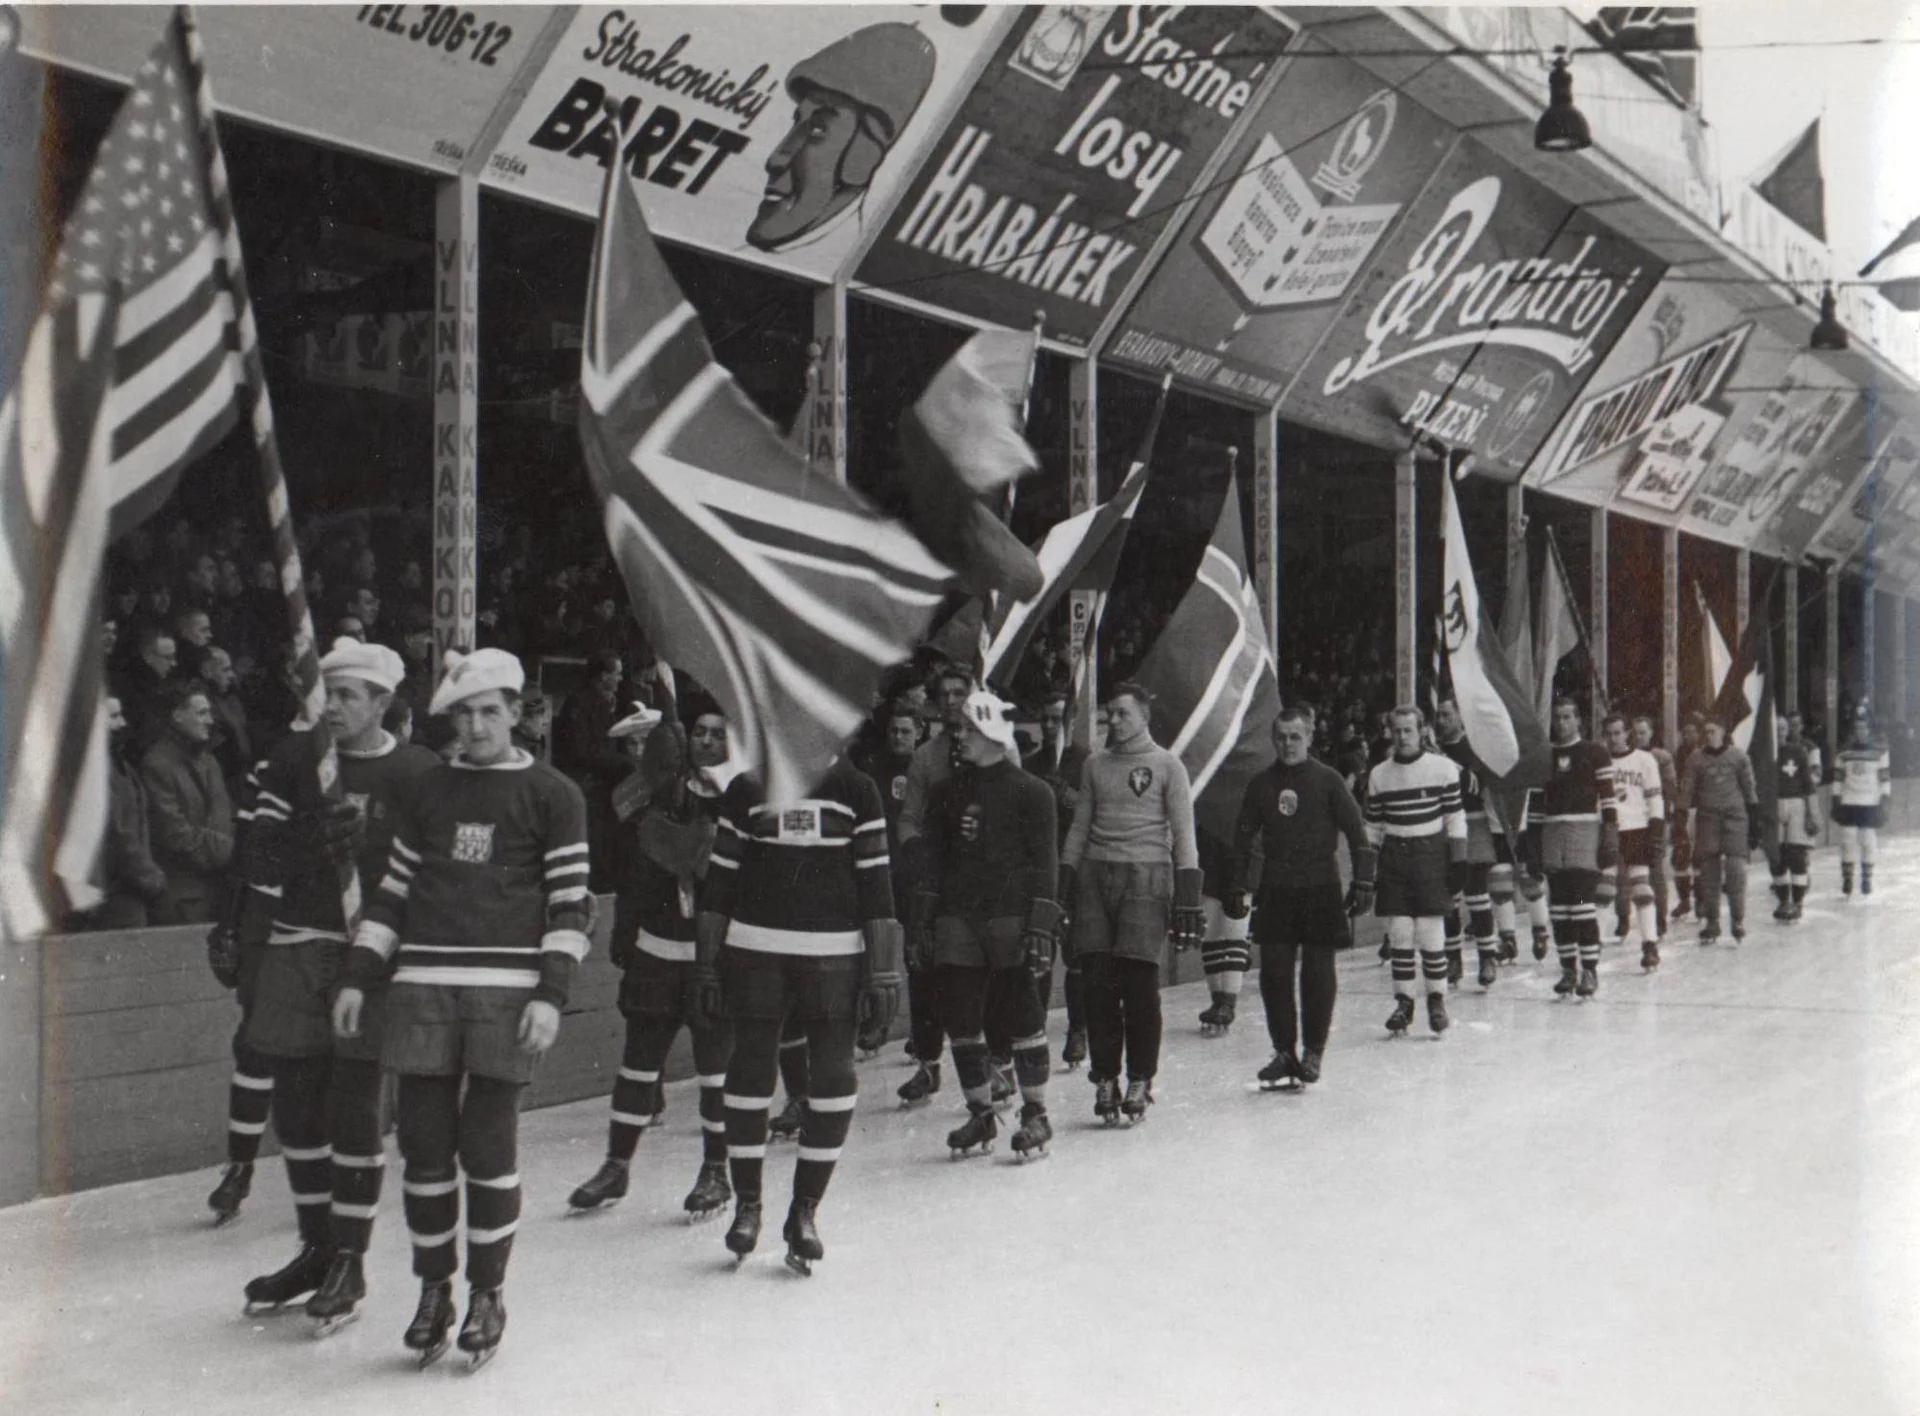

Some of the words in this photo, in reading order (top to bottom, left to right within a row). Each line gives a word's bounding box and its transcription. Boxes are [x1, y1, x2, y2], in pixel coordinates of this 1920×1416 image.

[409, 5, 512, 66] 306-12
[583, 9, 778, 130] Strakonický
[528, 76, 752, 195] BARET
[1055, 73, 1183, 218] losy
[895, 124, 1138, 307] HRABÁNEK
[437, 239, 457, 394] VLNA
[1071, 399, 1088, 504] VLNA
